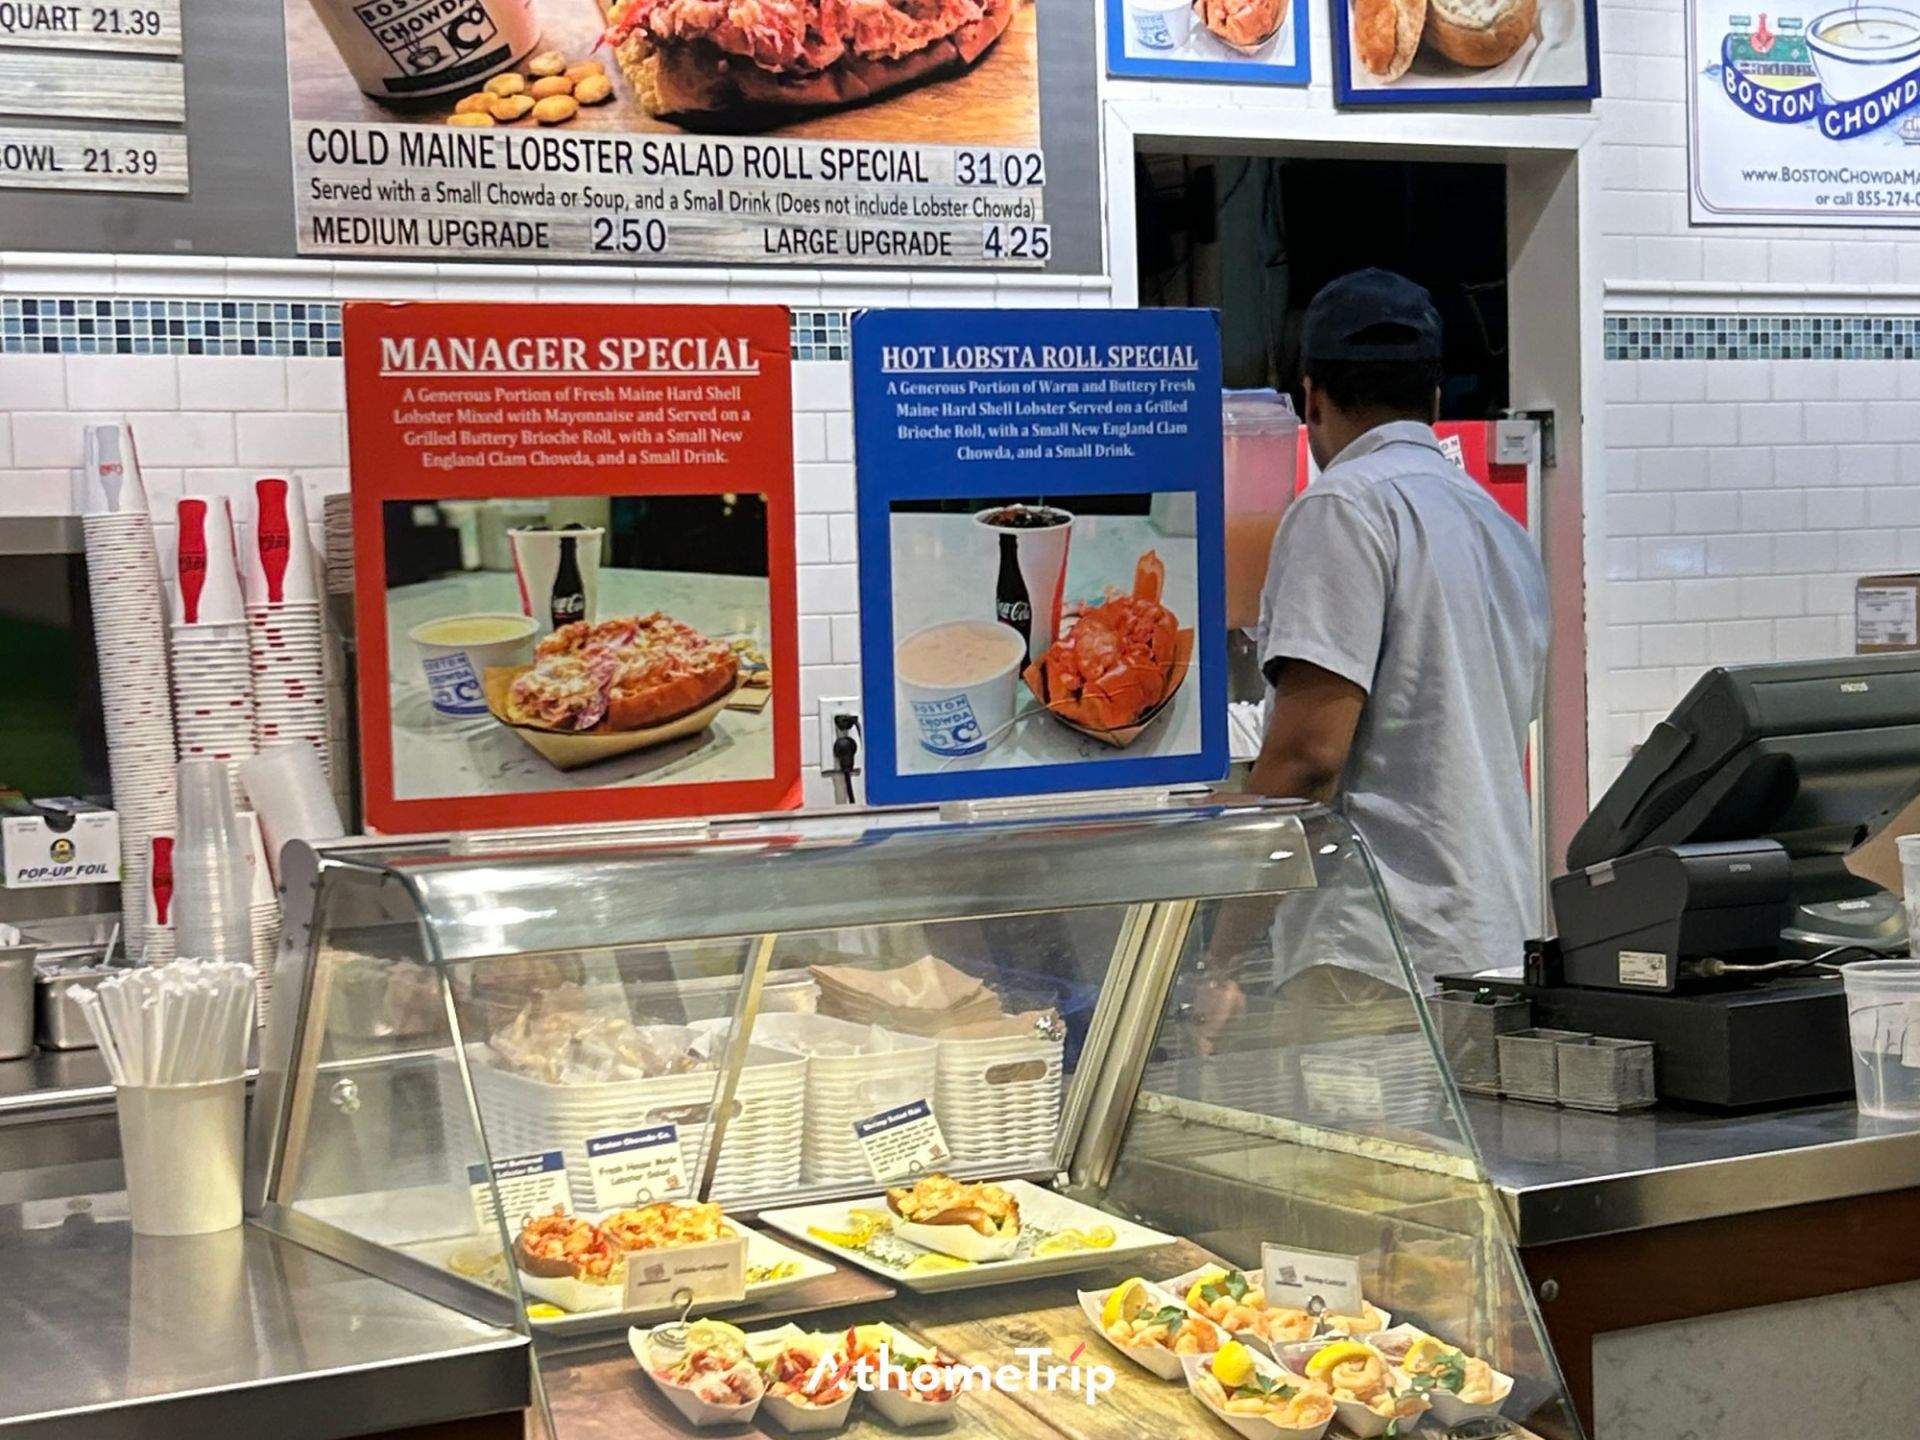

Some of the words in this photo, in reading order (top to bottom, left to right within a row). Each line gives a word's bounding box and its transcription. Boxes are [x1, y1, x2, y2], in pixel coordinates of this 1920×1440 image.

[0, 3, 81, 33] QUART
[92, 8, 160, 35] 21.39
[380, 0, 464, 43] CHOWD
[1725, 66, 1815, 117] BOSTON
[1824, 79, 1920, 136] CHOWD
[0, 144, 63, 171] OWL
[83, 148, 158, 175] 21.39
[307, 127, 389, 166] COLD
[400, 131, 497, 169] MAINE
[505, 135, 633, 174] LOBSTER
[642, 141, 733, 178] SALAD
[744, 146, 813, 180] ROLL
[820, 147, 929, 183] SPECIAL
[311, 177, 372, 202] Served
[378, 181, 415, 203] with
[421, 188, 431, 203] a
[436, 181, 482, 205] Small
[487, 183, 556, 207] Chowda
[561, 191, 579, 207] or
[583, 187, 630, 214] Soup,
[635, 190, 665, 210] and
[670, 195, 680, 210] a
[684, 189, 723, 212] Small
[730, 190, 771, 213] Drink
[776, 191, 820, 216] (Does
[826, 196, 851, 215] not
[854, 193, 909, 217] include
[914, 195, 968, 218] Lobster
[973, 197, 1036, 221] Chowda)
[1815, 193, 1829, 205] or
[1833, 193, 1853, 205] call
[312, 216, 420, 247] MEDIUM
[428, 219, 550, 249] UPGRADE
[594, 216, 668, 252] 2.50
[764, 227, 838, 256] LARGE
[845, 229, 953, 257] UPGRADE
[984, 224, 1050, 260] 4.25
[380, 336, 589, 371] MANAGER
[599, 336, 760, 371] SPECIAL
[882, 346, 936, 369] HOT
[942, 346, 1036, 369] LOBSTA
[1042, 346, 1102, 369] ROLL
[1107, 345, 1199, 368] SPECIAL
[402, 388, 414, 403] A
[416, 387, 491, 403] Generous
[495, 387, 551, 403] Portion
[555, 386, 572, 402] of
[574, 386, 615, 402] Fresh
[618, 387, 663, 402] Maine
[666, 385, 703, 401] Hard
[706, 385, 741, 401] Shell
[887, 382, 898, 395] A
[900, 381, 966, 395] Generous
[969, 380, 1020, 394] Portion
[1023, 380, 1038, 394] of
[1038, 380, 1079, 394] Warm
[1082, 379, 1107, 393] and
[1110, 379, 1157, 396] Buttery
[1160, 378, 1195, 392] Fresh
[393, 409, 454, 425] Lobster
[456, 408, 505, 424] Mixed
[507, 408, 542, 423] with
[545, 407, 635, 427] Mayonnaise
[638, 408, 665, 423] and
[667, 407, 718, 422] Served
[721, 411, 739, 422] on
[741, 411, 751, 421] a
[896, 403, 939, 417] Maine
[942, 402, 976, 417] Hard
[979, 401, 1013, 416] Shell
[1015, 402, 1066, 416] Lobster
[1068, 401, 1113, 416] Served
[1115, 404, 1132, 415] on
[1134, 404, 1143, 414] a
[1145, 399, 1188, 414] Grilled
[403, 430, 457, 446] Grilled
[460, 430, 518, 449] Buttery
[520, 429, 580, 446] Brioche
[583, 429, 615, 446] Roll,
[618, 428, 653, 445] with
[655, 432, 664, 444] a
[666, 428, 709, 444] Small
[711, 429, 743, 443] New
[898, 425, 952, 440] Brioche
[954, 424, 985, 440] Roll,
[988, 424, 1018, 438] with
[1020, 427, 1030, 438] a
[1032, 423, 1068, 437] Small
[1071, 423, 1101, 437] New
[1103, 422, 1154, 439] England
[1156, 421, 1188, 436] Clam
[422, 452, 485, 472] England
[488, 451, 528, 468] Clam
[530, 451, 594, 469] Chowda,
[597, 450, 624, 466] and
[628, 454, 637, 466] a
[640, 450, 681, 466] Small
[684, 449, 728, 465] Drink.
[957, 446, 1014, 462] Chowda,
[1016, 445, 1042, 460] and
[1045, 448, 1053, 459] a
[1055, 445, 1092, 459] Small
[1095, 444, 1135, 458] Drink.
[18, 866, 73, 880] POP-UP
[76, 863, 108, 876] FOIL
